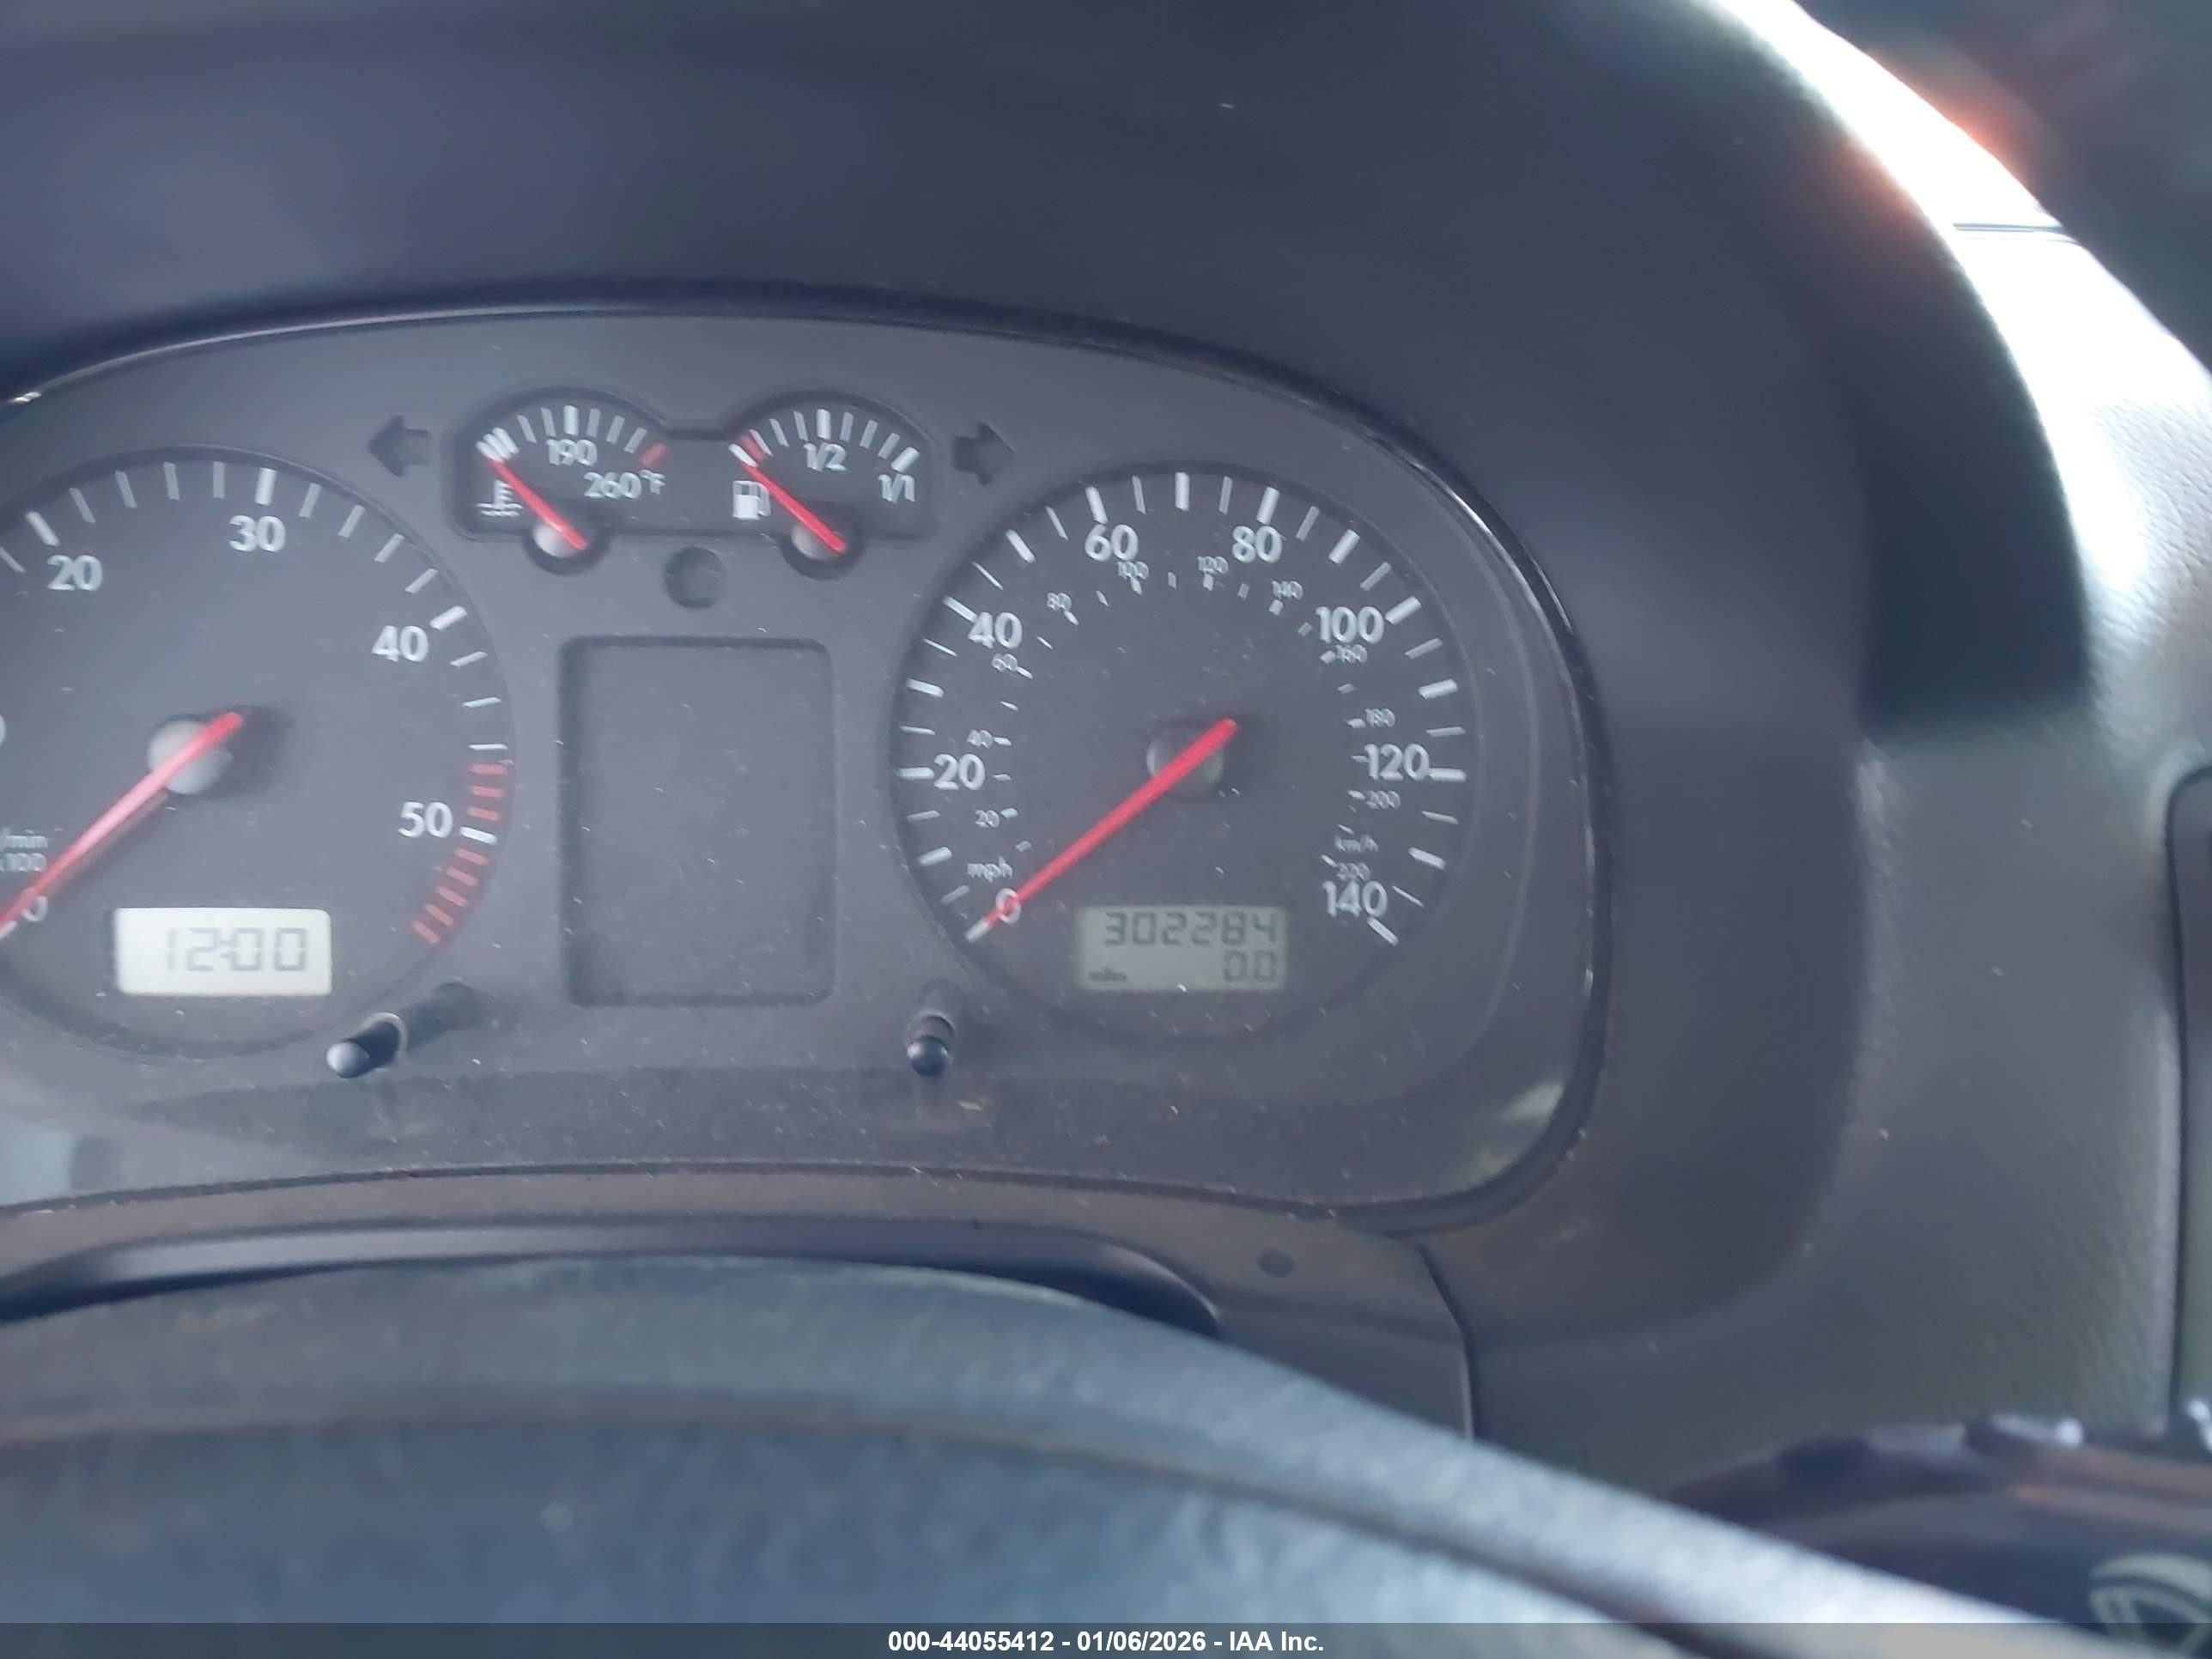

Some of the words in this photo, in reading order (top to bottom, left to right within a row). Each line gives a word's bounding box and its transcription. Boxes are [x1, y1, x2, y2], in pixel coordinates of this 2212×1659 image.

[546, 439, 598, 466] 190
[805, 444, 847, 472] 1/2
[228, 515, 286, 553] 30
[1085, 524, 1139, 562] 60
[1232, 526, 1283, 563] 80
[47, 555, 102, 591] 20
[1117, 561, 1149, 580] 100
[1197, 556, 1229, 574] 120
[1046, 592, 1072, 611] 80
[968, 612, 1023, 649] 40
[1315, 606, 1384, 643] 100
[372, 625, 428, 662] 40
[992, 653, 1018, 672] 60
[967, 730, 994, 749] 40
[934, 754, 986, 790] 20
[1364, 744, 1430, 781] 120
[1366, 790, 1401, 809] 200
[398, 801, 453, 838] 50
[975, 811, 1000, 828] 20
[967, 856, 1013, 883] mph
[995, 888, 1022, 925] 0
[1322, 880, 1388, 918] 140
[1104, 911, 1278, 946] 302284
[165, 927, 307, 973] 12:00
